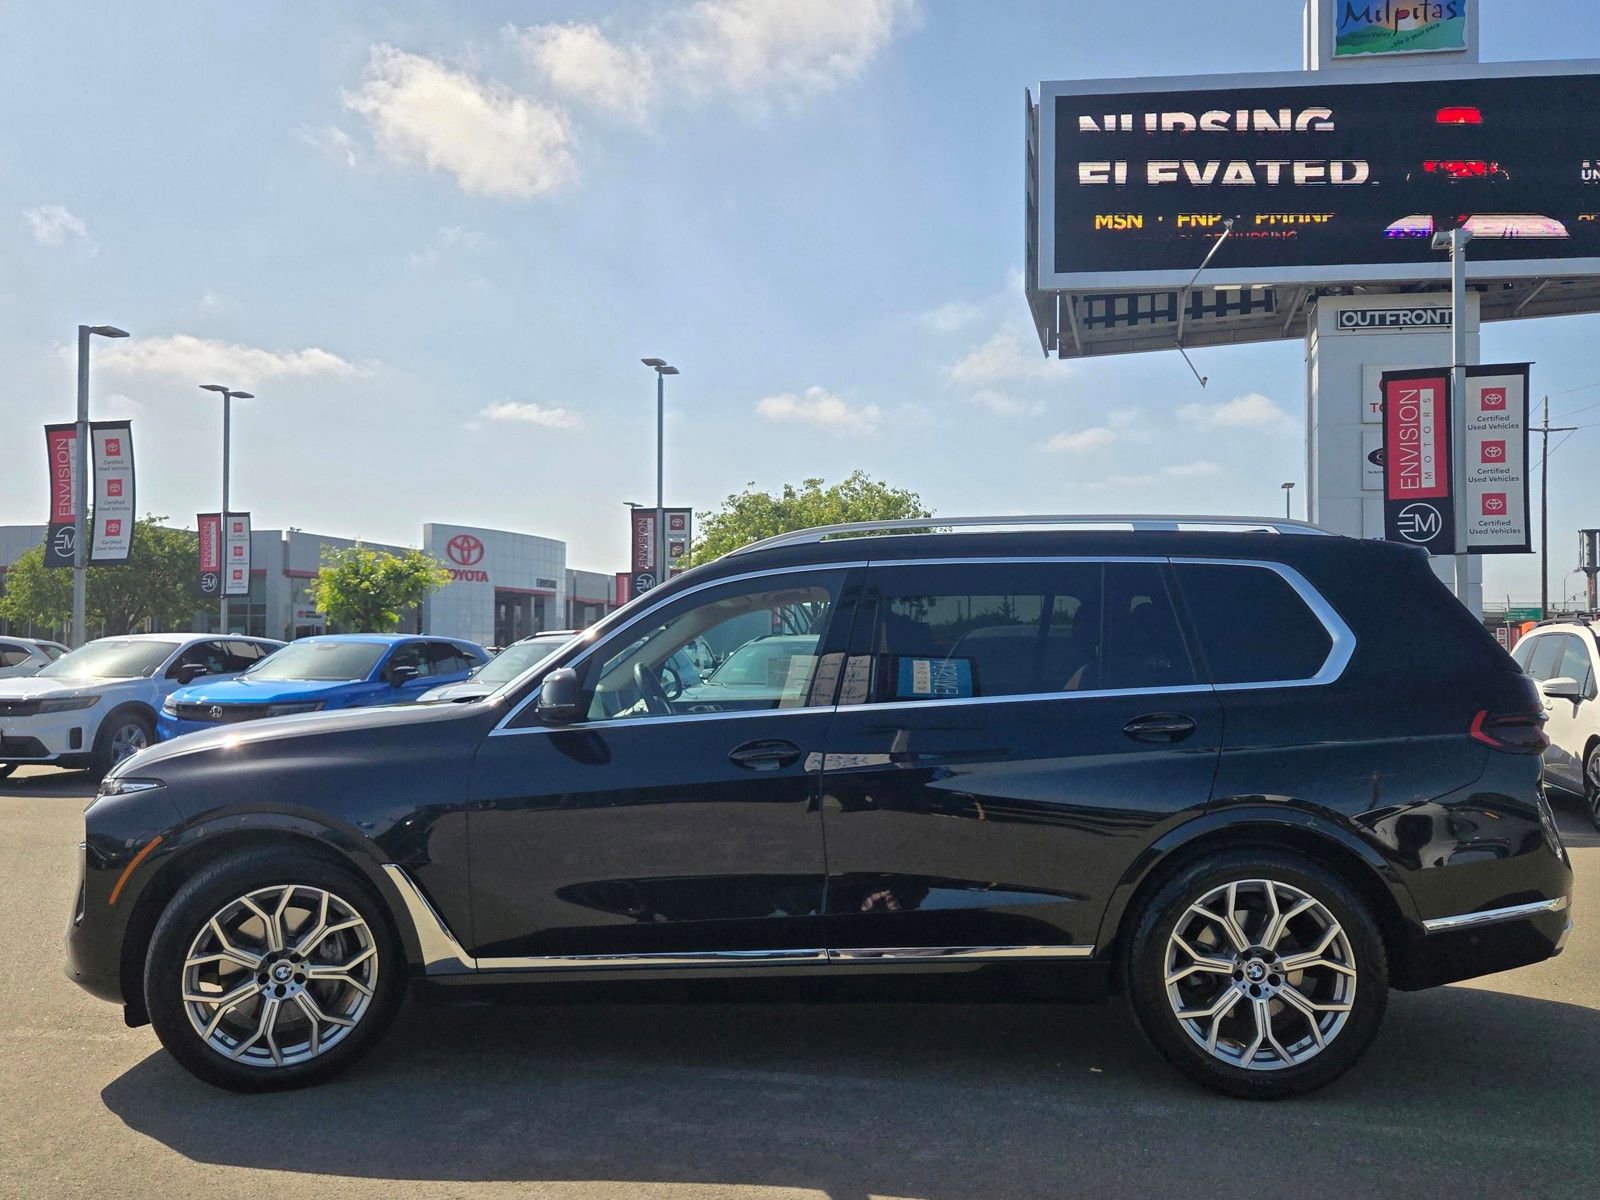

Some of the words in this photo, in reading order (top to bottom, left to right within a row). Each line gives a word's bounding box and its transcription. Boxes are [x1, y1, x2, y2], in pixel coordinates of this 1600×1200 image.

[1340, 0, 1457, 36] Milpitas
[1095, 213, 1143, 230] MSN
[1342, 309, 1450, 326] OUTFRONT
[1399, 388, 1419, 490] ENVISION
[1423, 397, 1432, 480] MOTORS
[56, 438, 71, 516] ENVISION
[1477, 467, 1510, 475] Certified
[1478, 519, 1511, 527] Certified
[638, 518, 647, 567] ENVISION
[442, 568, 489, 582] OYOTA
